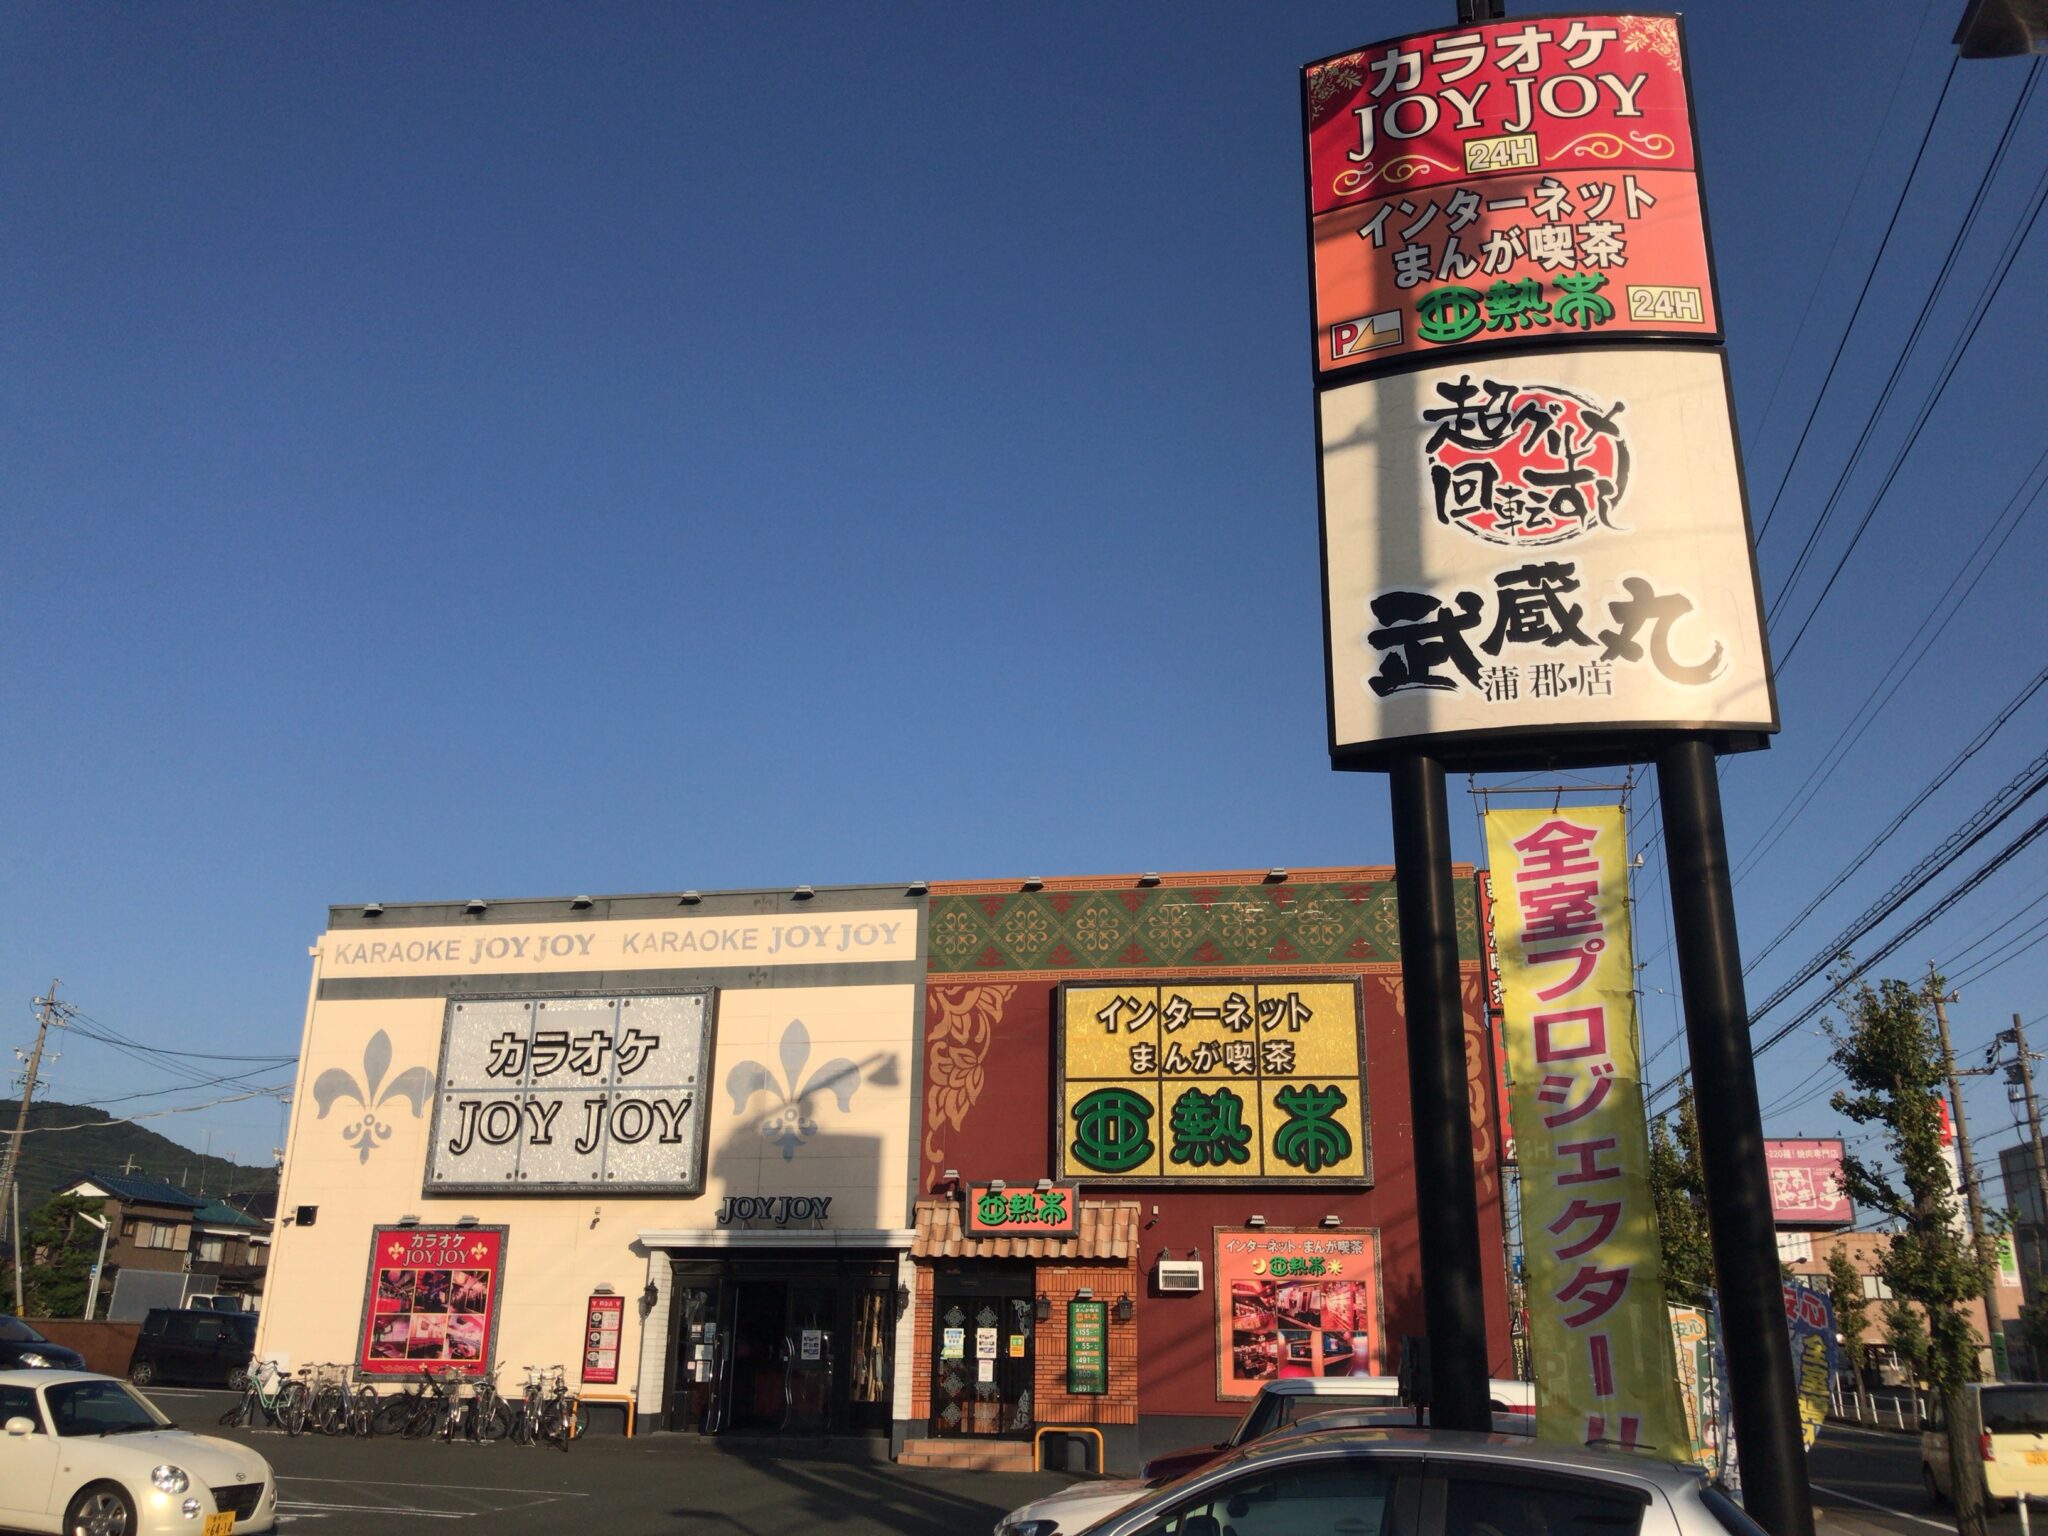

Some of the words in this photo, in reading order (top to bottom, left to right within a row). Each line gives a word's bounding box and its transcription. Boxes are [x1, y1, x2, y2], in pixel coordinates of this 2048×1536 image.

[1370, 22, 1617, 98] カラオケ
[1347, 81, 1489, 162] JOY
[1503, 73, 1648, 133] JOY
[1467, 138, 1537, 169] 24H
[1358, 176, 1657, 248] インターネット
[1393, 222, 1628, 289] まんが喫茶
[1631, 289, 1701, 319] 24H
[1367, 562, 1728, 697] 武蔵丸
[334, 940, 461, 964] KARAOKE
[469, 936, 529, 965] JOY
[534, 933, 595, 962] JOY
[622, 928, 758, 954] KARAOKE
[768, 925, 832, 954] JOY
[836, 922, 901, 952] JOY
[1096, 993, 1312, 1034] インターネット
[486, 1029, 660, 1077] カラオケ
[1129, 1040, 1297, 1074] まんが喫茶
[449, 1100, 562, 1155] JOY
[575, 1099, 692, 1154] JOY
[719, 1196, 776, 1224] JOY
[774, 1196, 832, 1222] JOY
[403, 1250, 437, 1266] JOY
[436, 1250, 470, 1266] JOY
[411, 1233, 466, 1248] カラオケ
